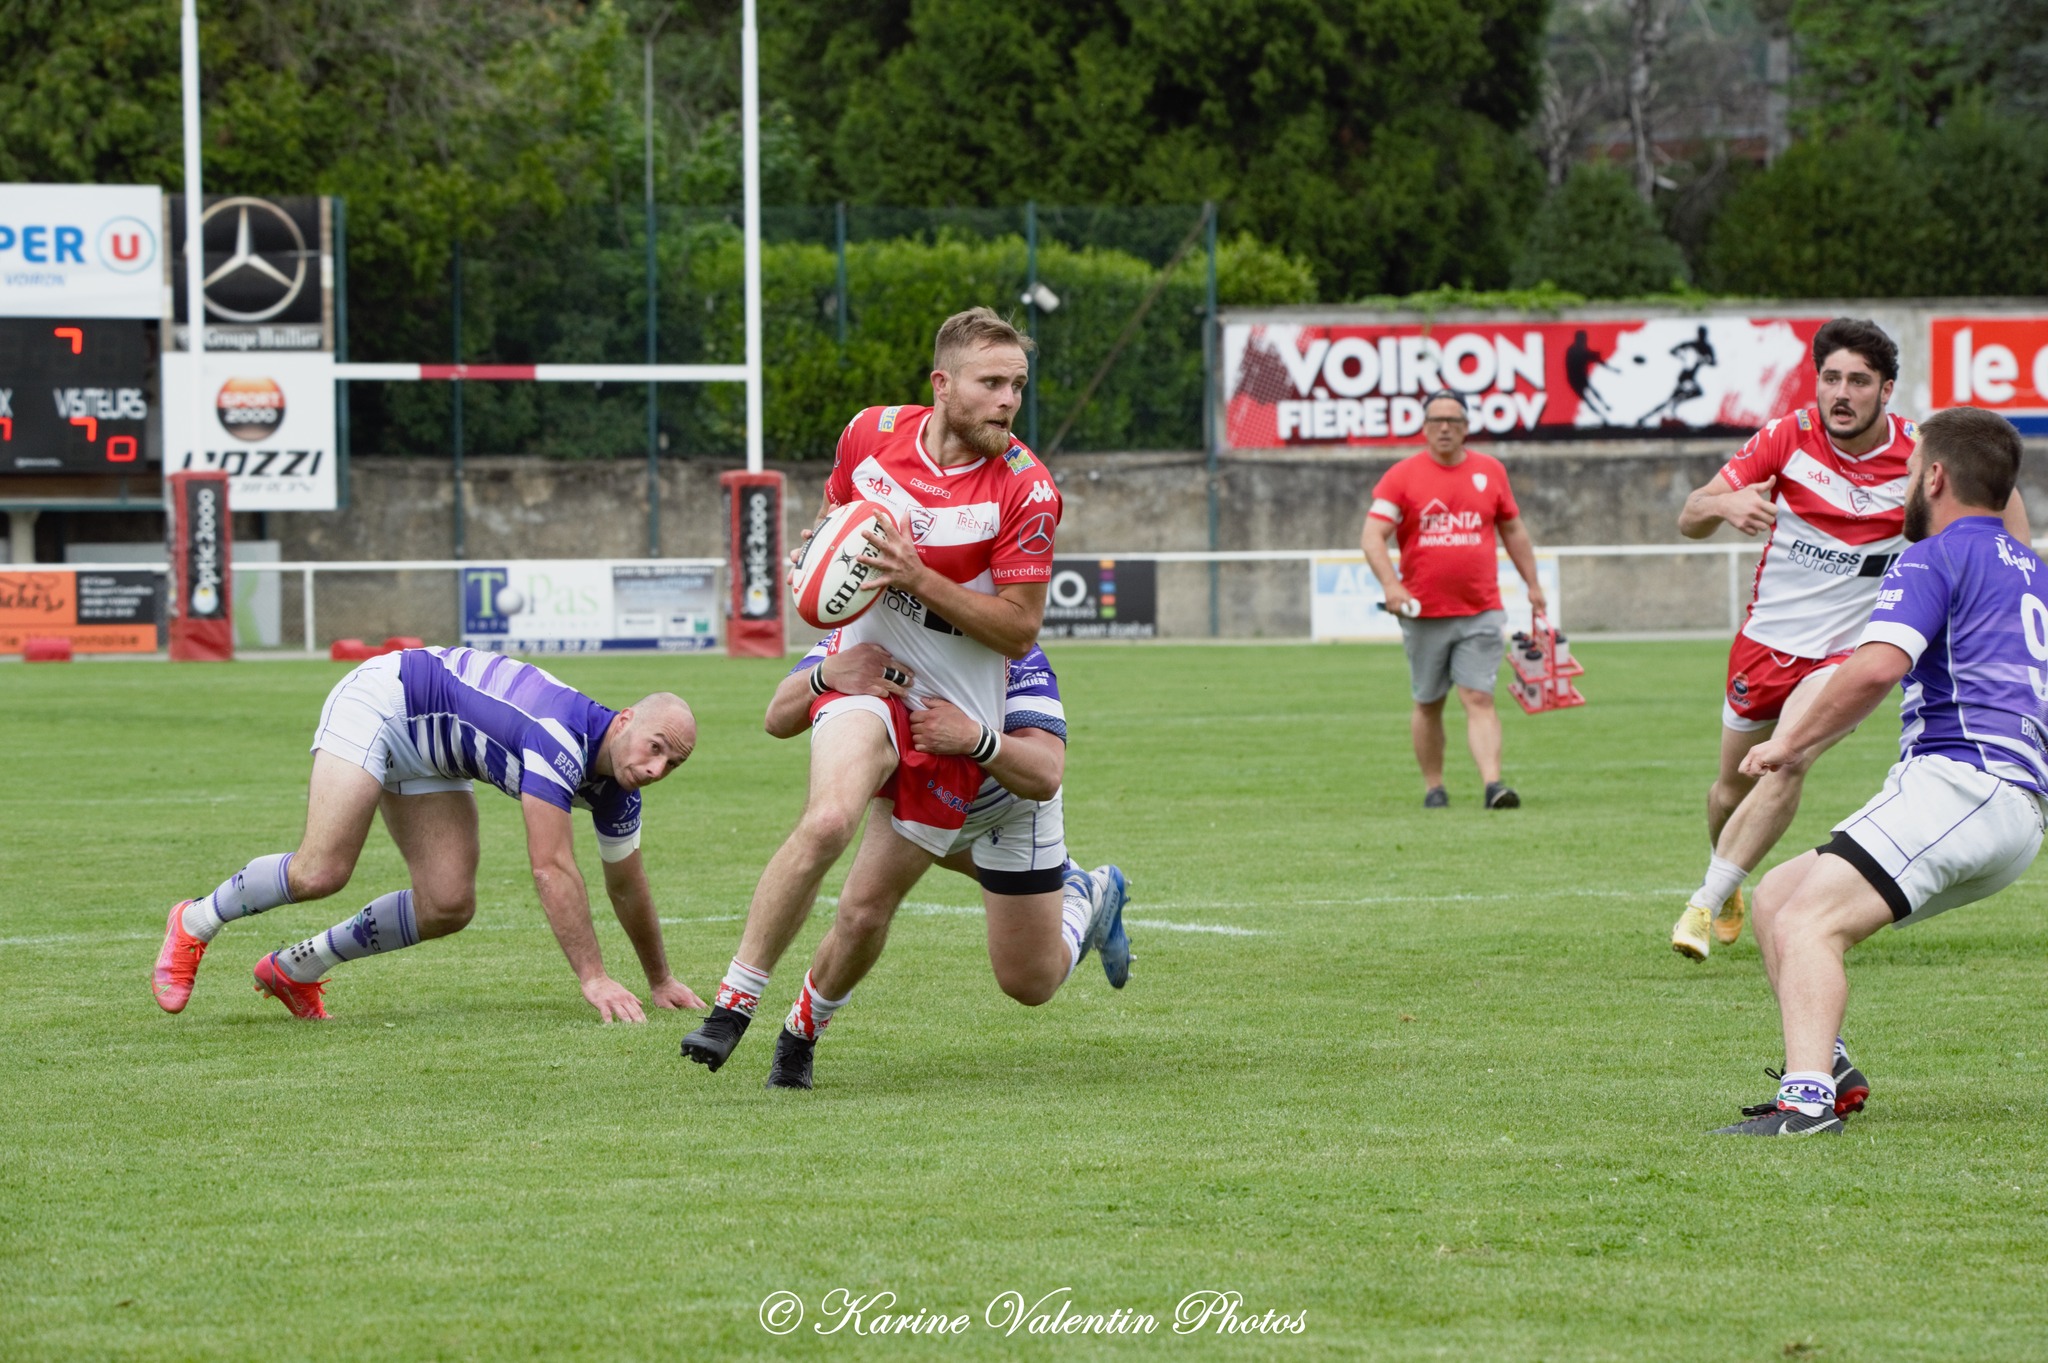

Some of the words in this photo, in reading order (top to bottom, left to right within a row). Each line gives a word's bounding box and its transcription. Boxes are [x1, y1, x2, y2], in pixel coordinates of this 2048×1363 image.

[111, 235, 139, 261] U
[5, 274, 66, 286] VOIRON
[54, 327, 83, 354] 7
[1276, 332, 1545, 397] VOIRON
[1953, 326, 2018, 403] le
[220, 391, 281, 407] SPORT
[224, 407, 278, 424] 2000
[1787, 551, 1858, 577] BOUTIQUE
[1791, 540, 1862, 565] FITNESS
[825, 521, 888, 615] GILBET
